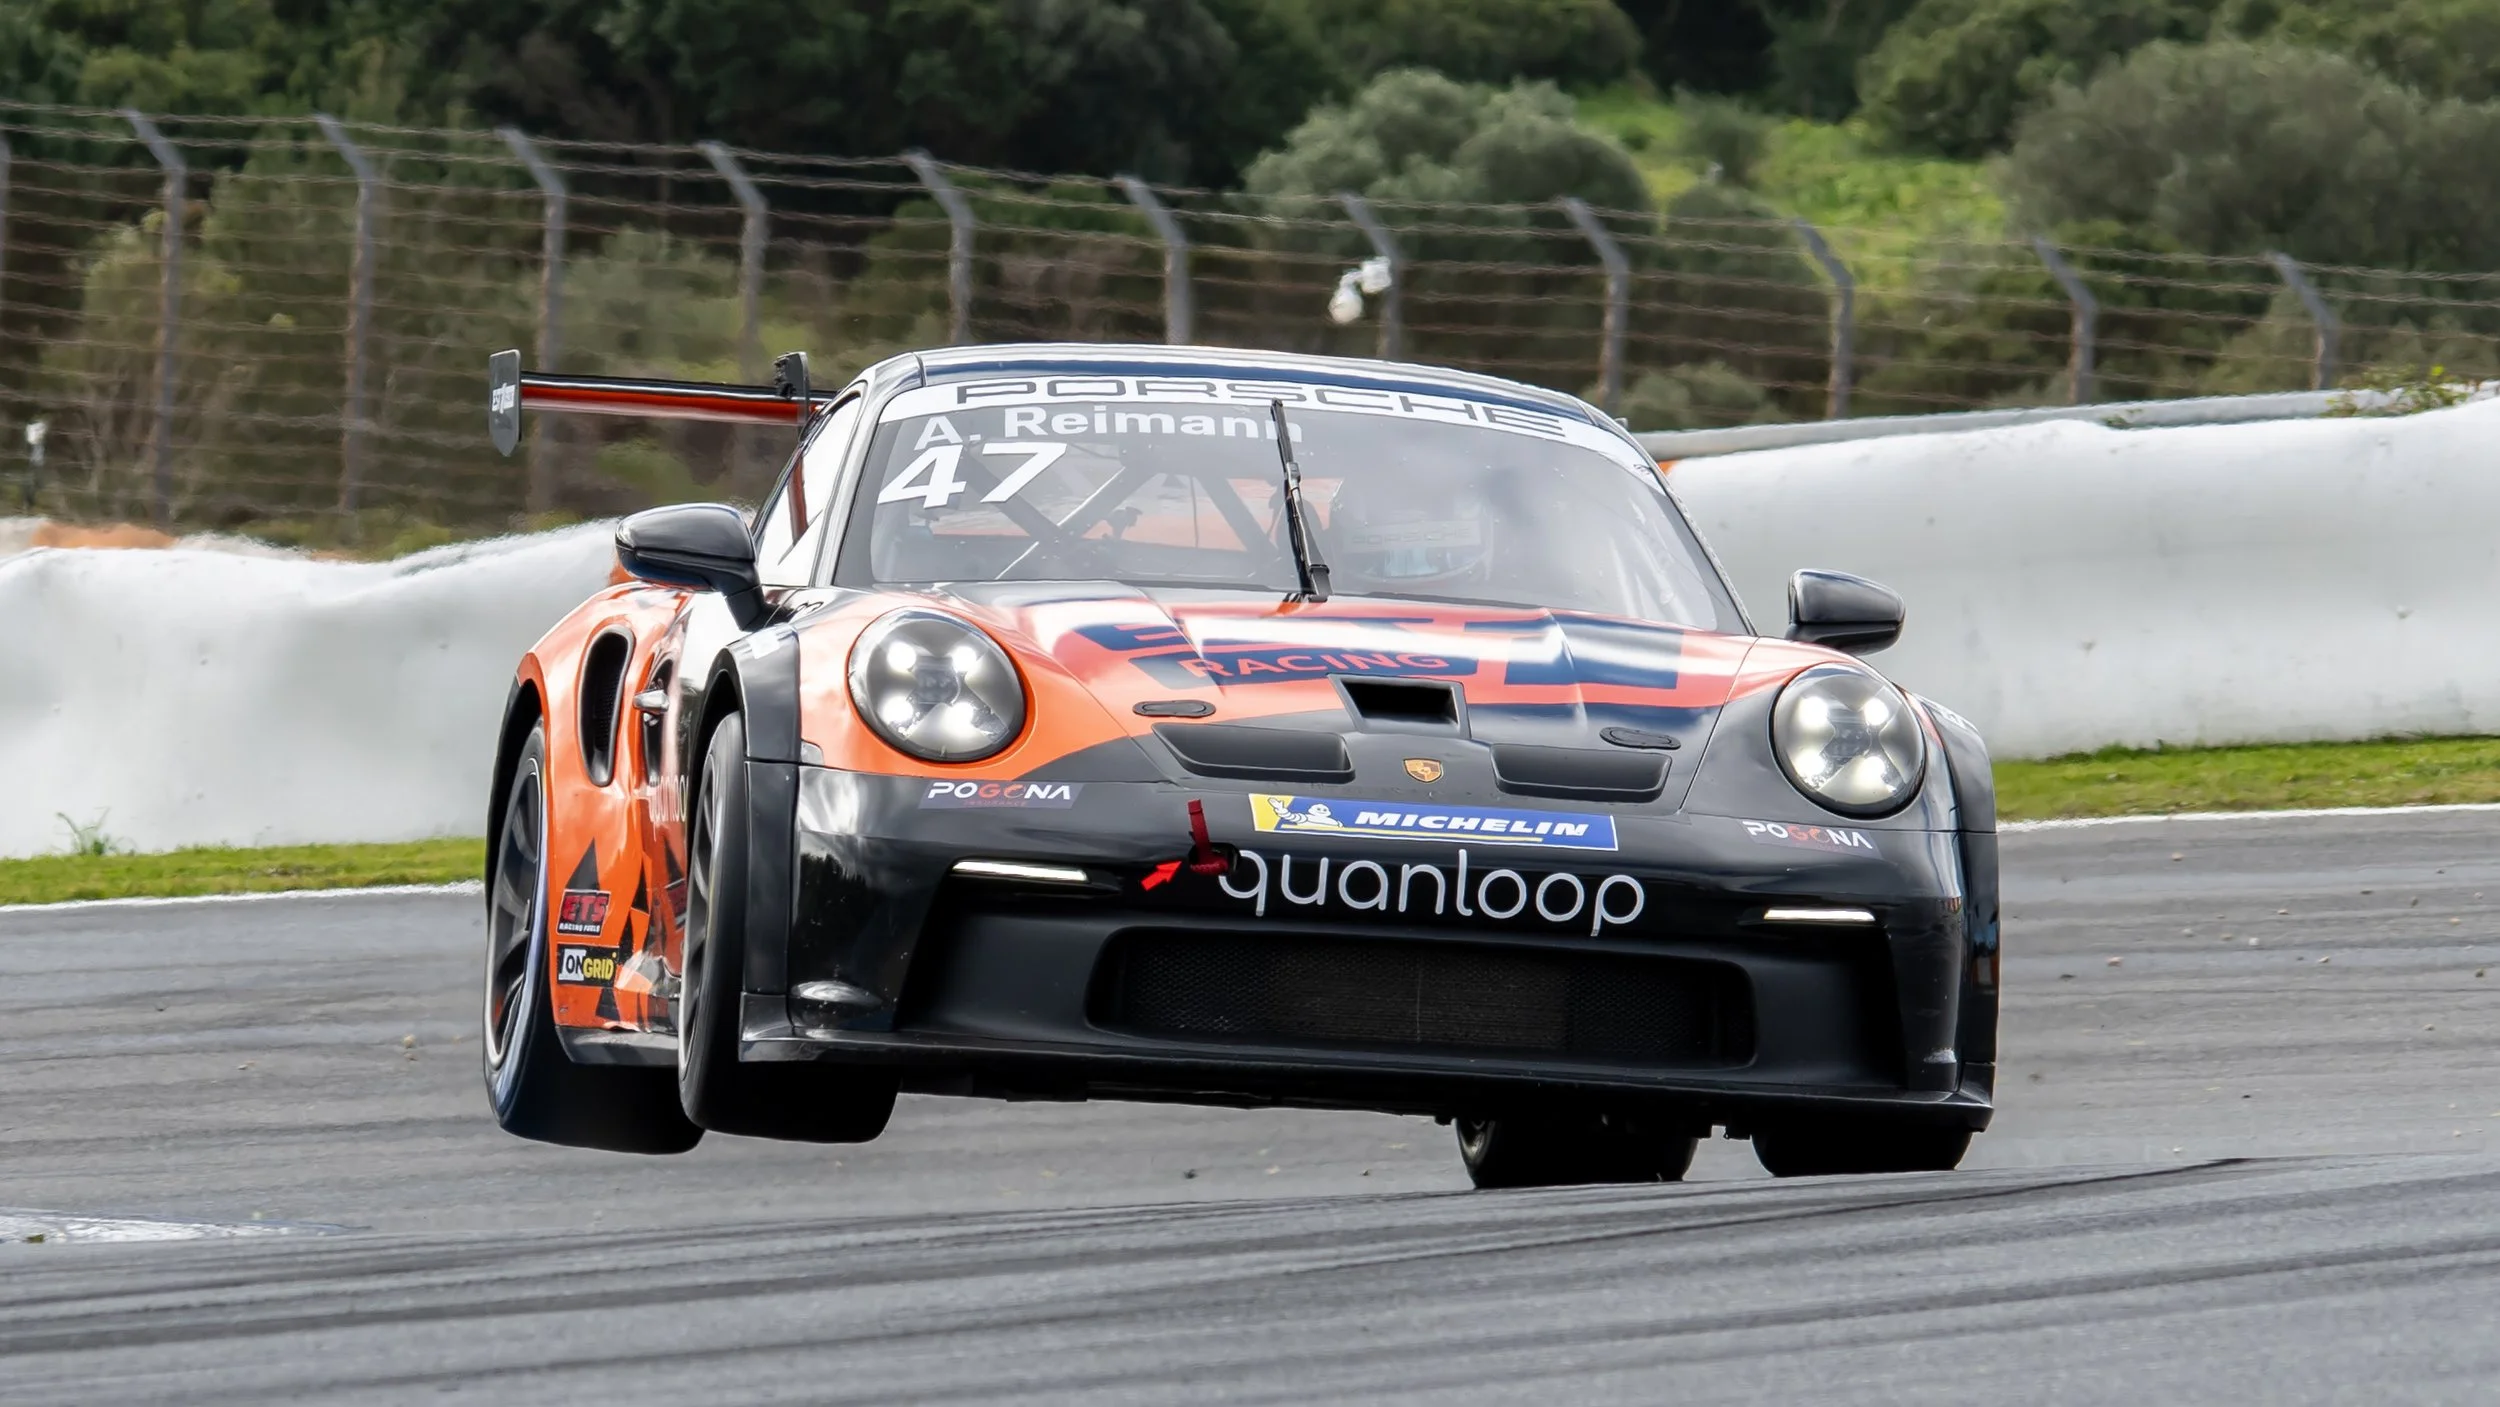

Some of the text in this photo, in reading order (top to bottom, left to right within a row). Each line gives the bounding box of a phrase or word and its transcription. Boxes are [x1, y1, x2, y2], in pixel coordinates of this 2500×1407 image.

[957, 379, 1566, 437] PORSCHE
[914, 405, 1303, 450] A. Reimann
[877, 441, 1067, 509] 47
[1178, 653, 1449, 677] RACING
[928, 782, 1071, 800] POGONA
[1354, 810, 1590, 837] MICHELIN
[1743, 820, 1873, 850] POGONA
[1217, 849, 1645, 937] quanloop
[562, 895, 609, 922] ETS
